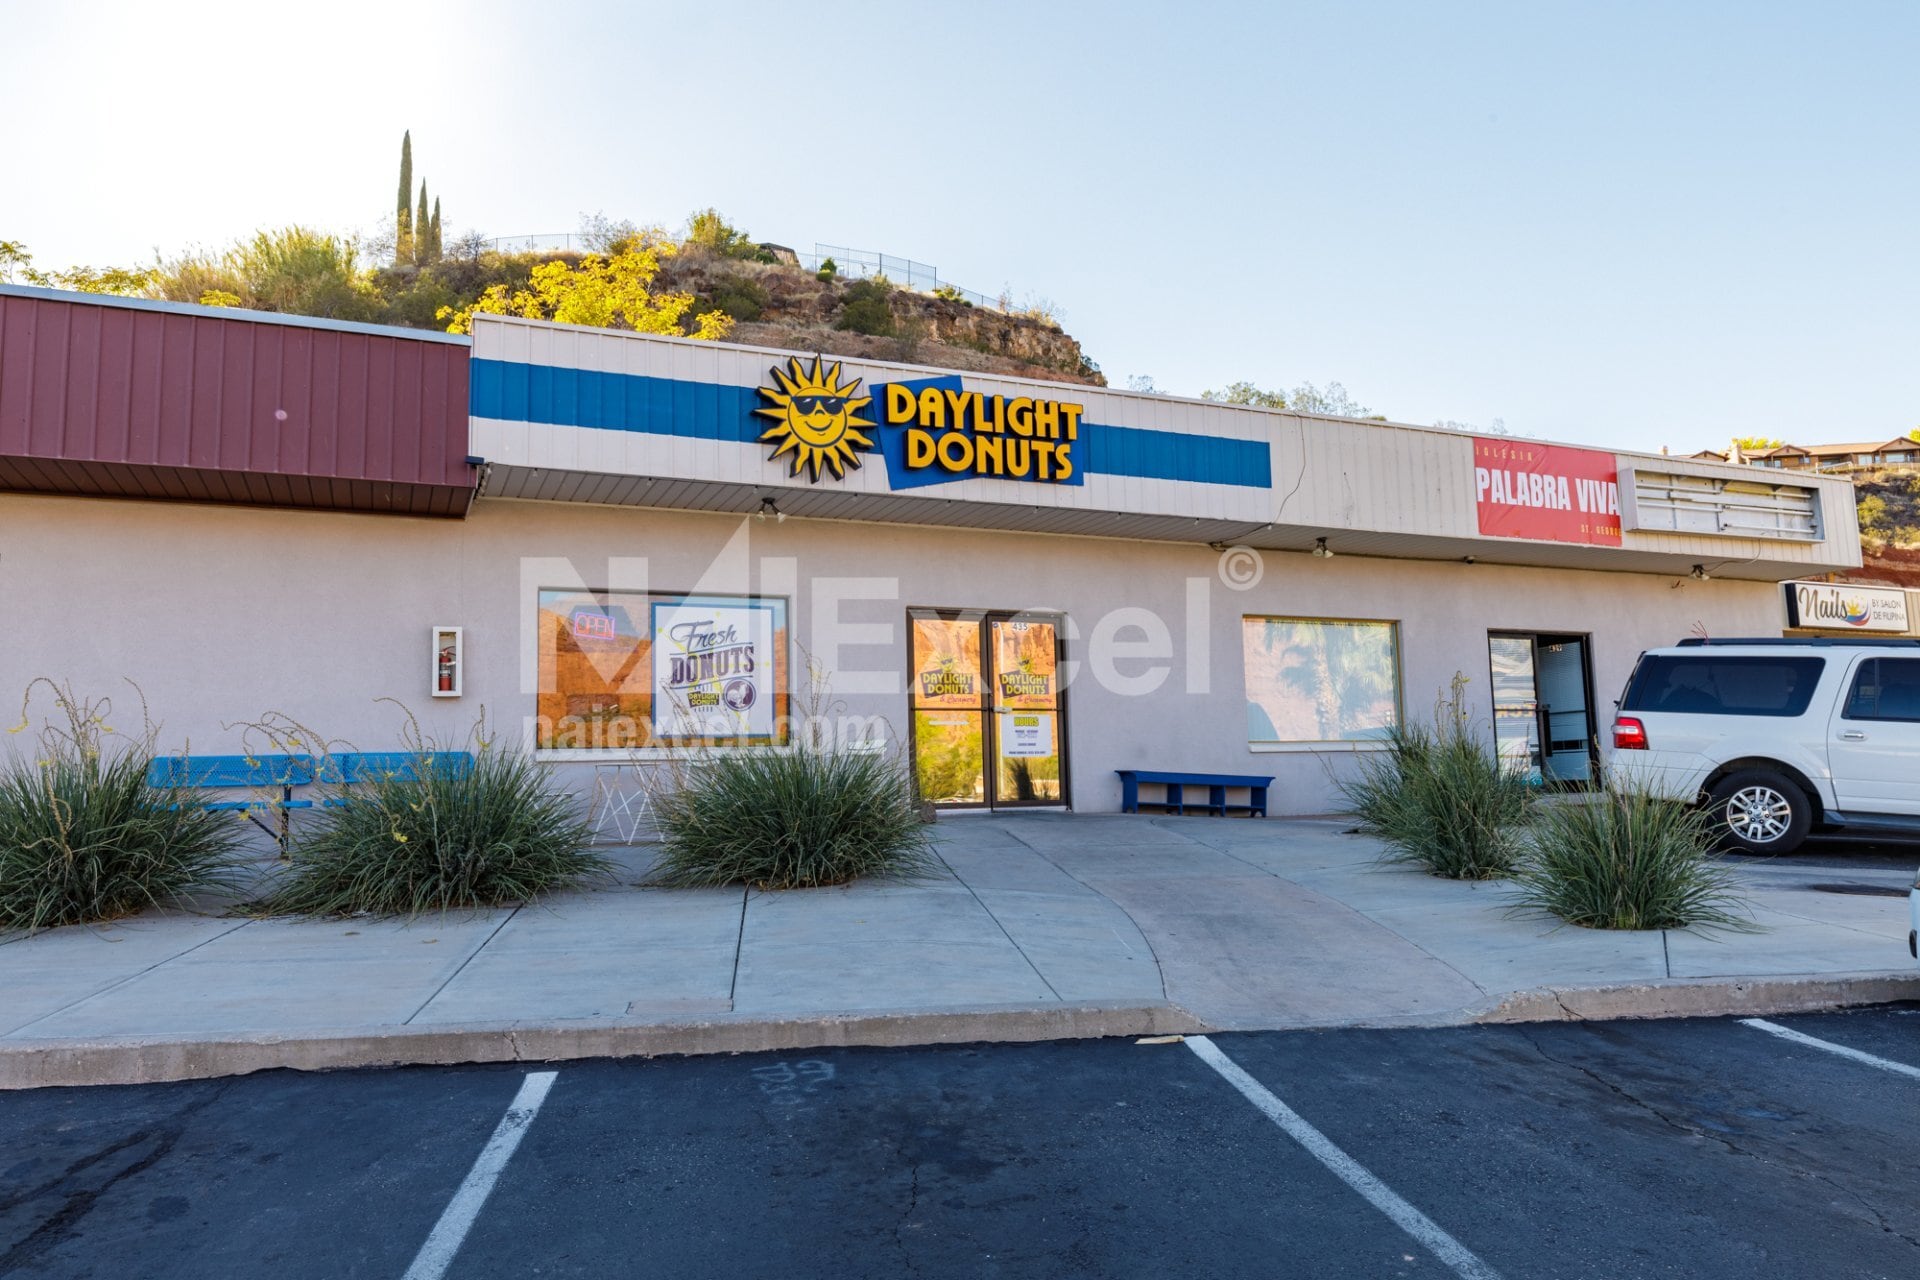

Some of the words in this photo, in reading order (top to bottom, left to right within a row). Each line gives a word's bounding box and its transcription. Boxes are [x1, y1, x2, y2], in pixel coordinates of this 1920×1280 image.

[885, 383, 1084, 441] DAYLIGHT
[905, 429, 1073, 480] DONUTS
[1475, 447, 1533, 462] IGLESIA
[1475, 467, 1572, 511] PALABRA
[1575, 478, 1621, 516] VIVA
[1798, 587, 1849, 620] Nails
[576, 614, 613, 637] OPEN
[670, 620, 738, 653] Fresh
[1012, 622, 1029, 631] 435
[670, 645, 755, 684] DONUTS
[922, 672, 974, 684] DAYLIGHT
[927, 683, 970, 694] DONUTS
[1001, 674, 1049, 685] DAYLIGHT
[1006, 684, 1046, 695] DONUTS
